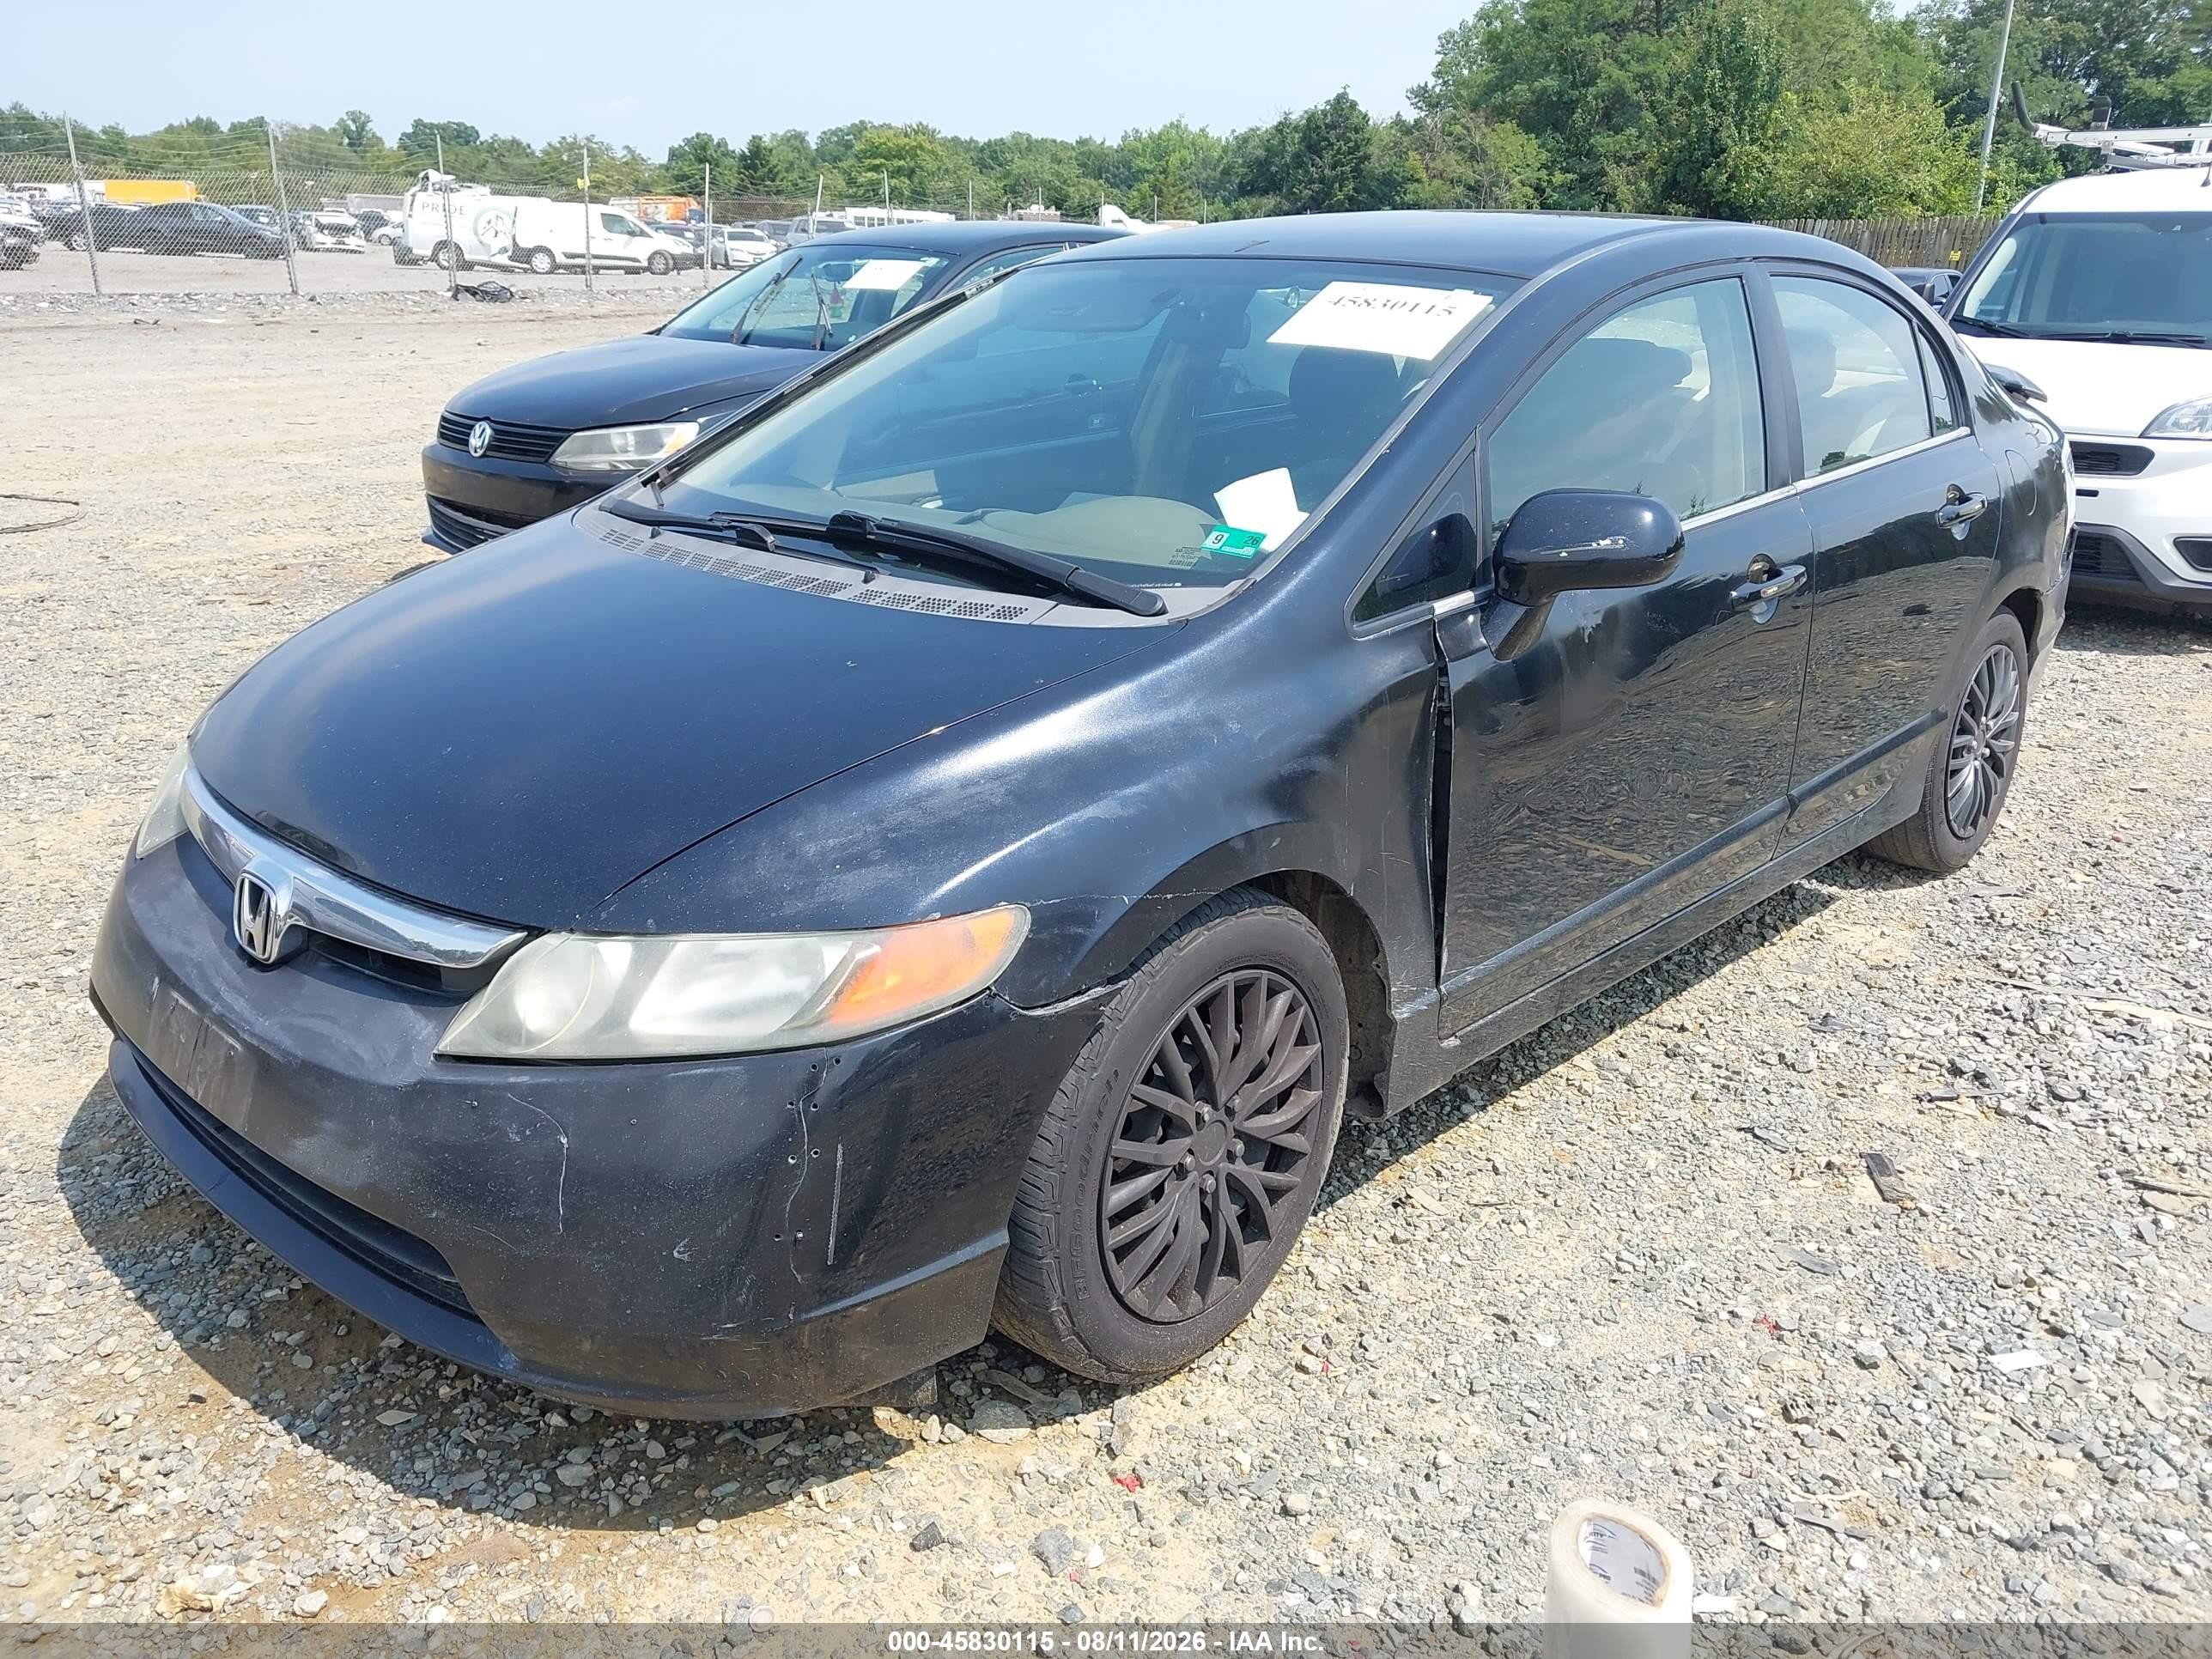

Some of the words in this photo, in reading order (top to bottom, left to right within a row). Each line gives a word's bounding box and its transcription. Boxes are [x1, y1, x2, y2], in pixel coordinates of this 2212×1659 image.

[422, 201, 467, 216] PRDE
[1328, 294, 1457, 317] 45830115
[1212, 534, 1224, 544] 9
[1243, 535, 1261, 546] 26
